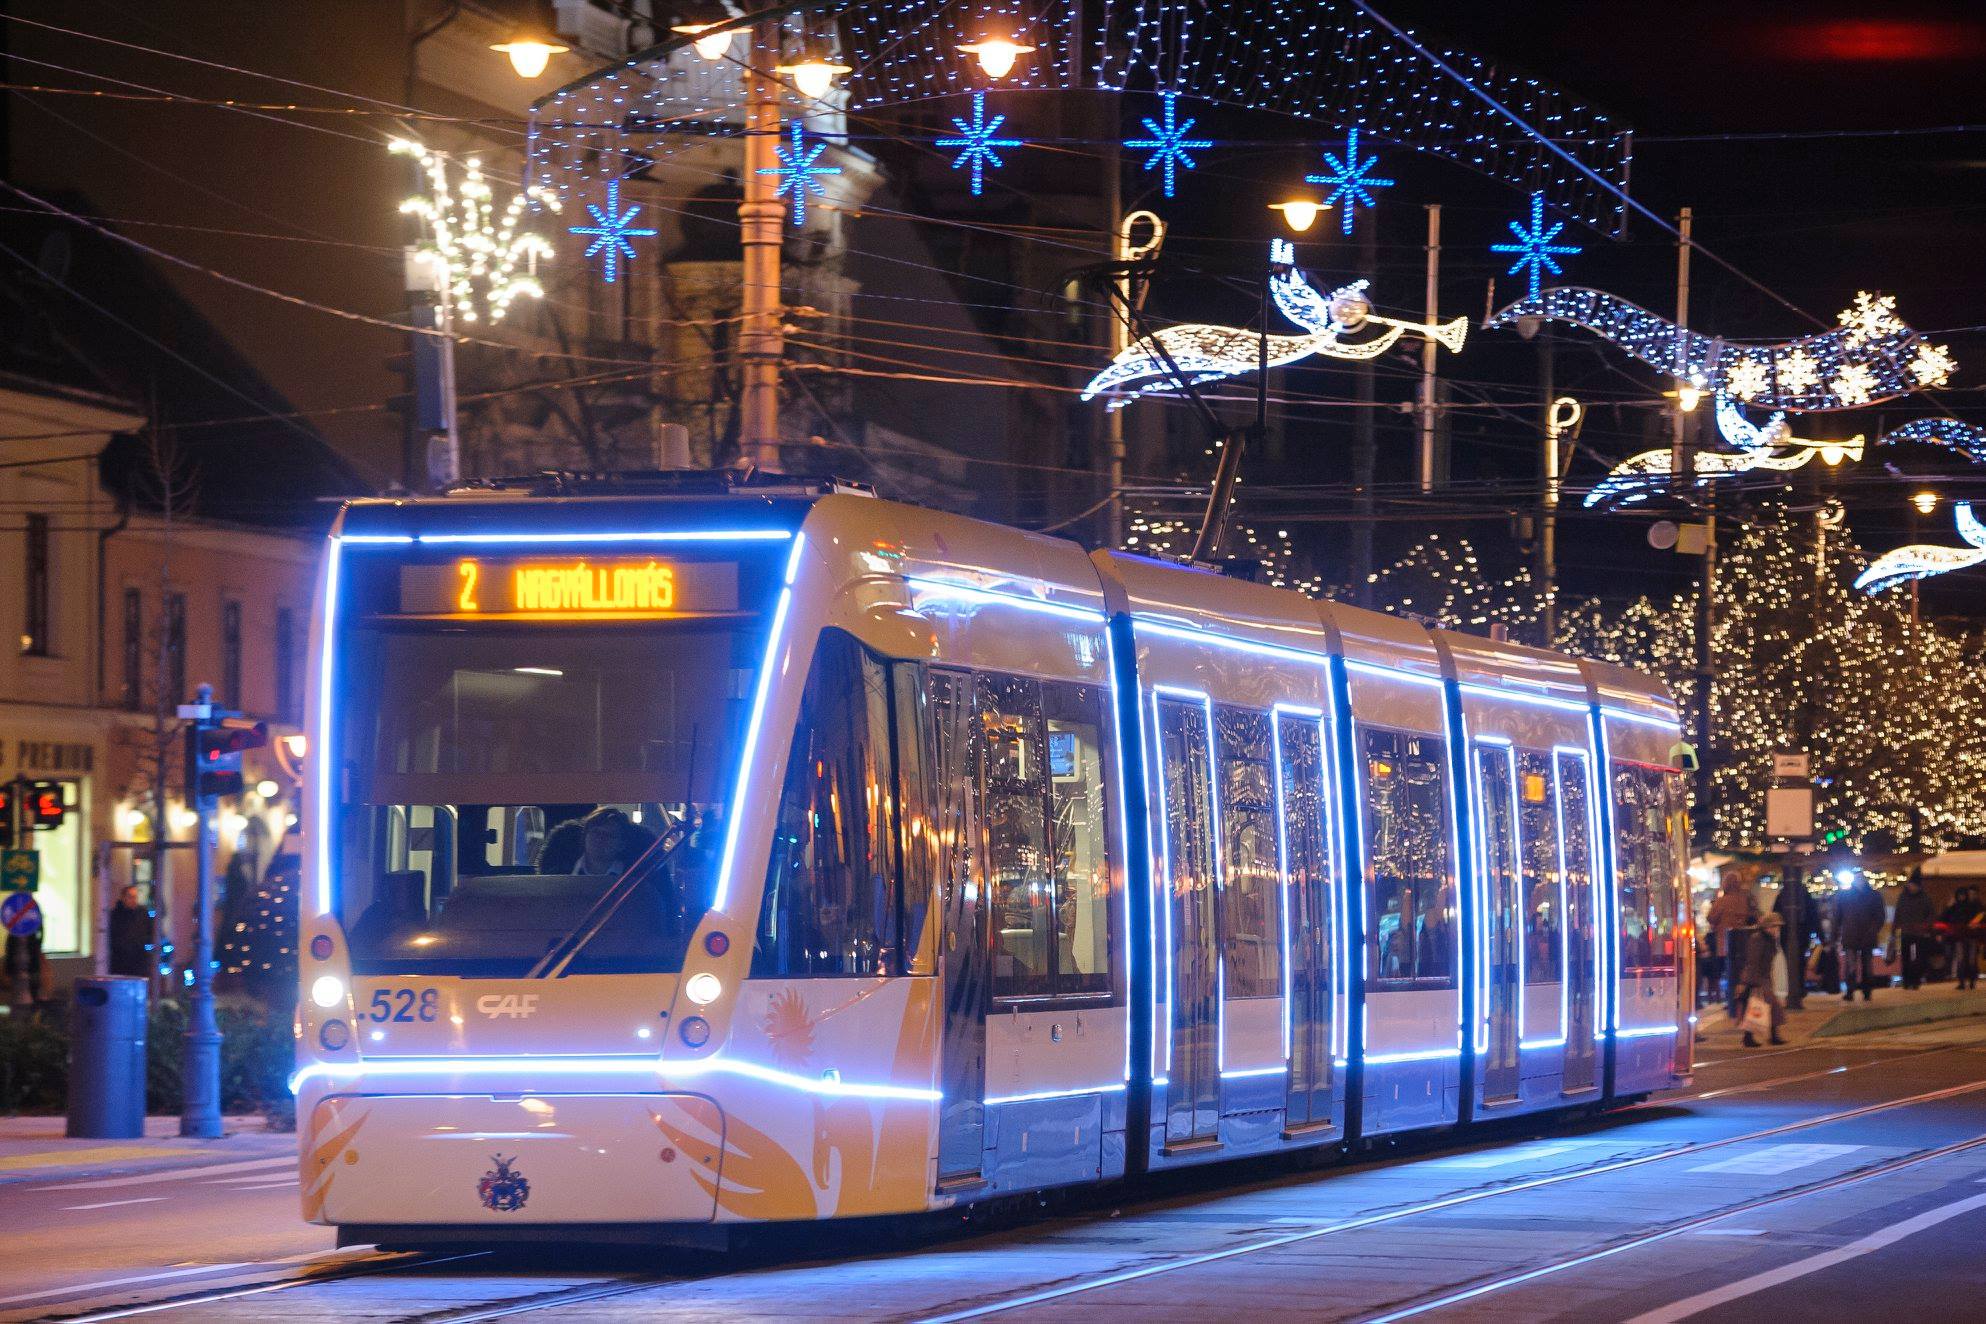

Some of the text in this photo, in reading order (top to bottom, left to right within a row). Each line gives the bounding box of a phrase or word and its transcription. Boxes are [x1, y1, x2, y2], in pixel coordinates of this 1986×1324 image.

[459, 562, 477, 610] 2
[369, 988, 439, 1024] 528
[477, 994, 540, 1018] CAF
